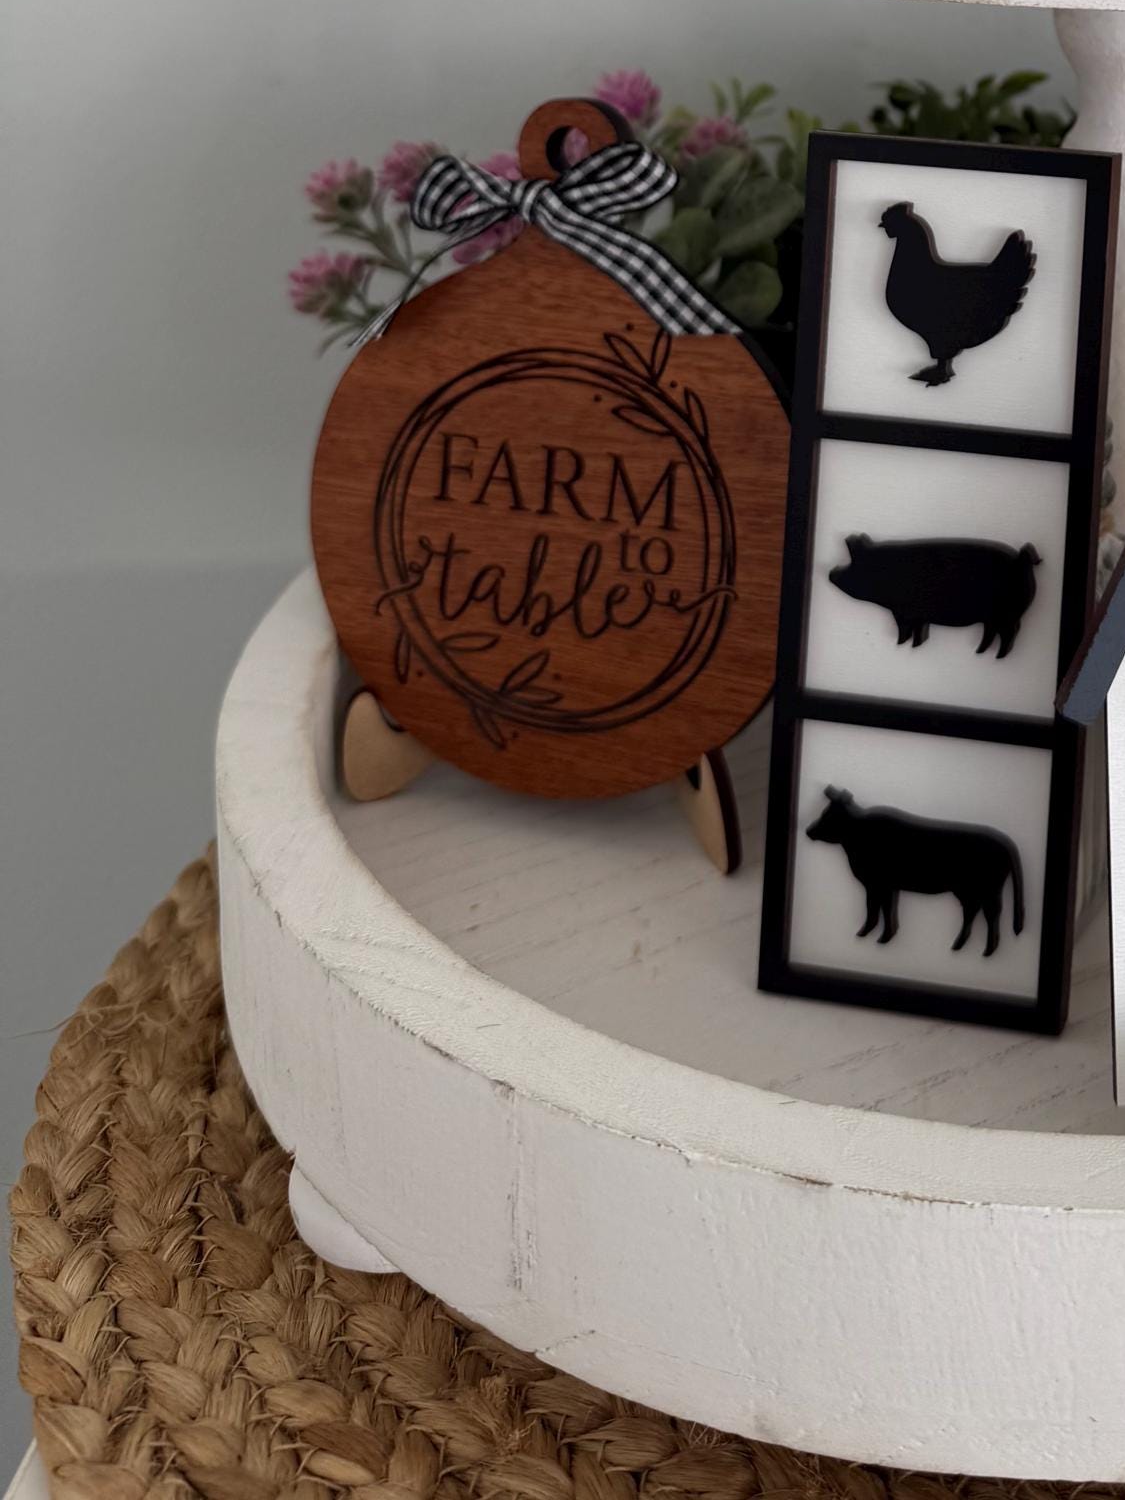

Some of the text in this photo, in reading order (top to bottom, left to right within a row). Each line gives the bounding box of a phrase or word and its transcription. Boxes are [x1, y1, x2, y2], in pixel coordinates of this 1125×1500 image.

[433, 432, 688, 532] FARM
[377, 531, 738, 639] table
[617, 528, 675, 576] to
